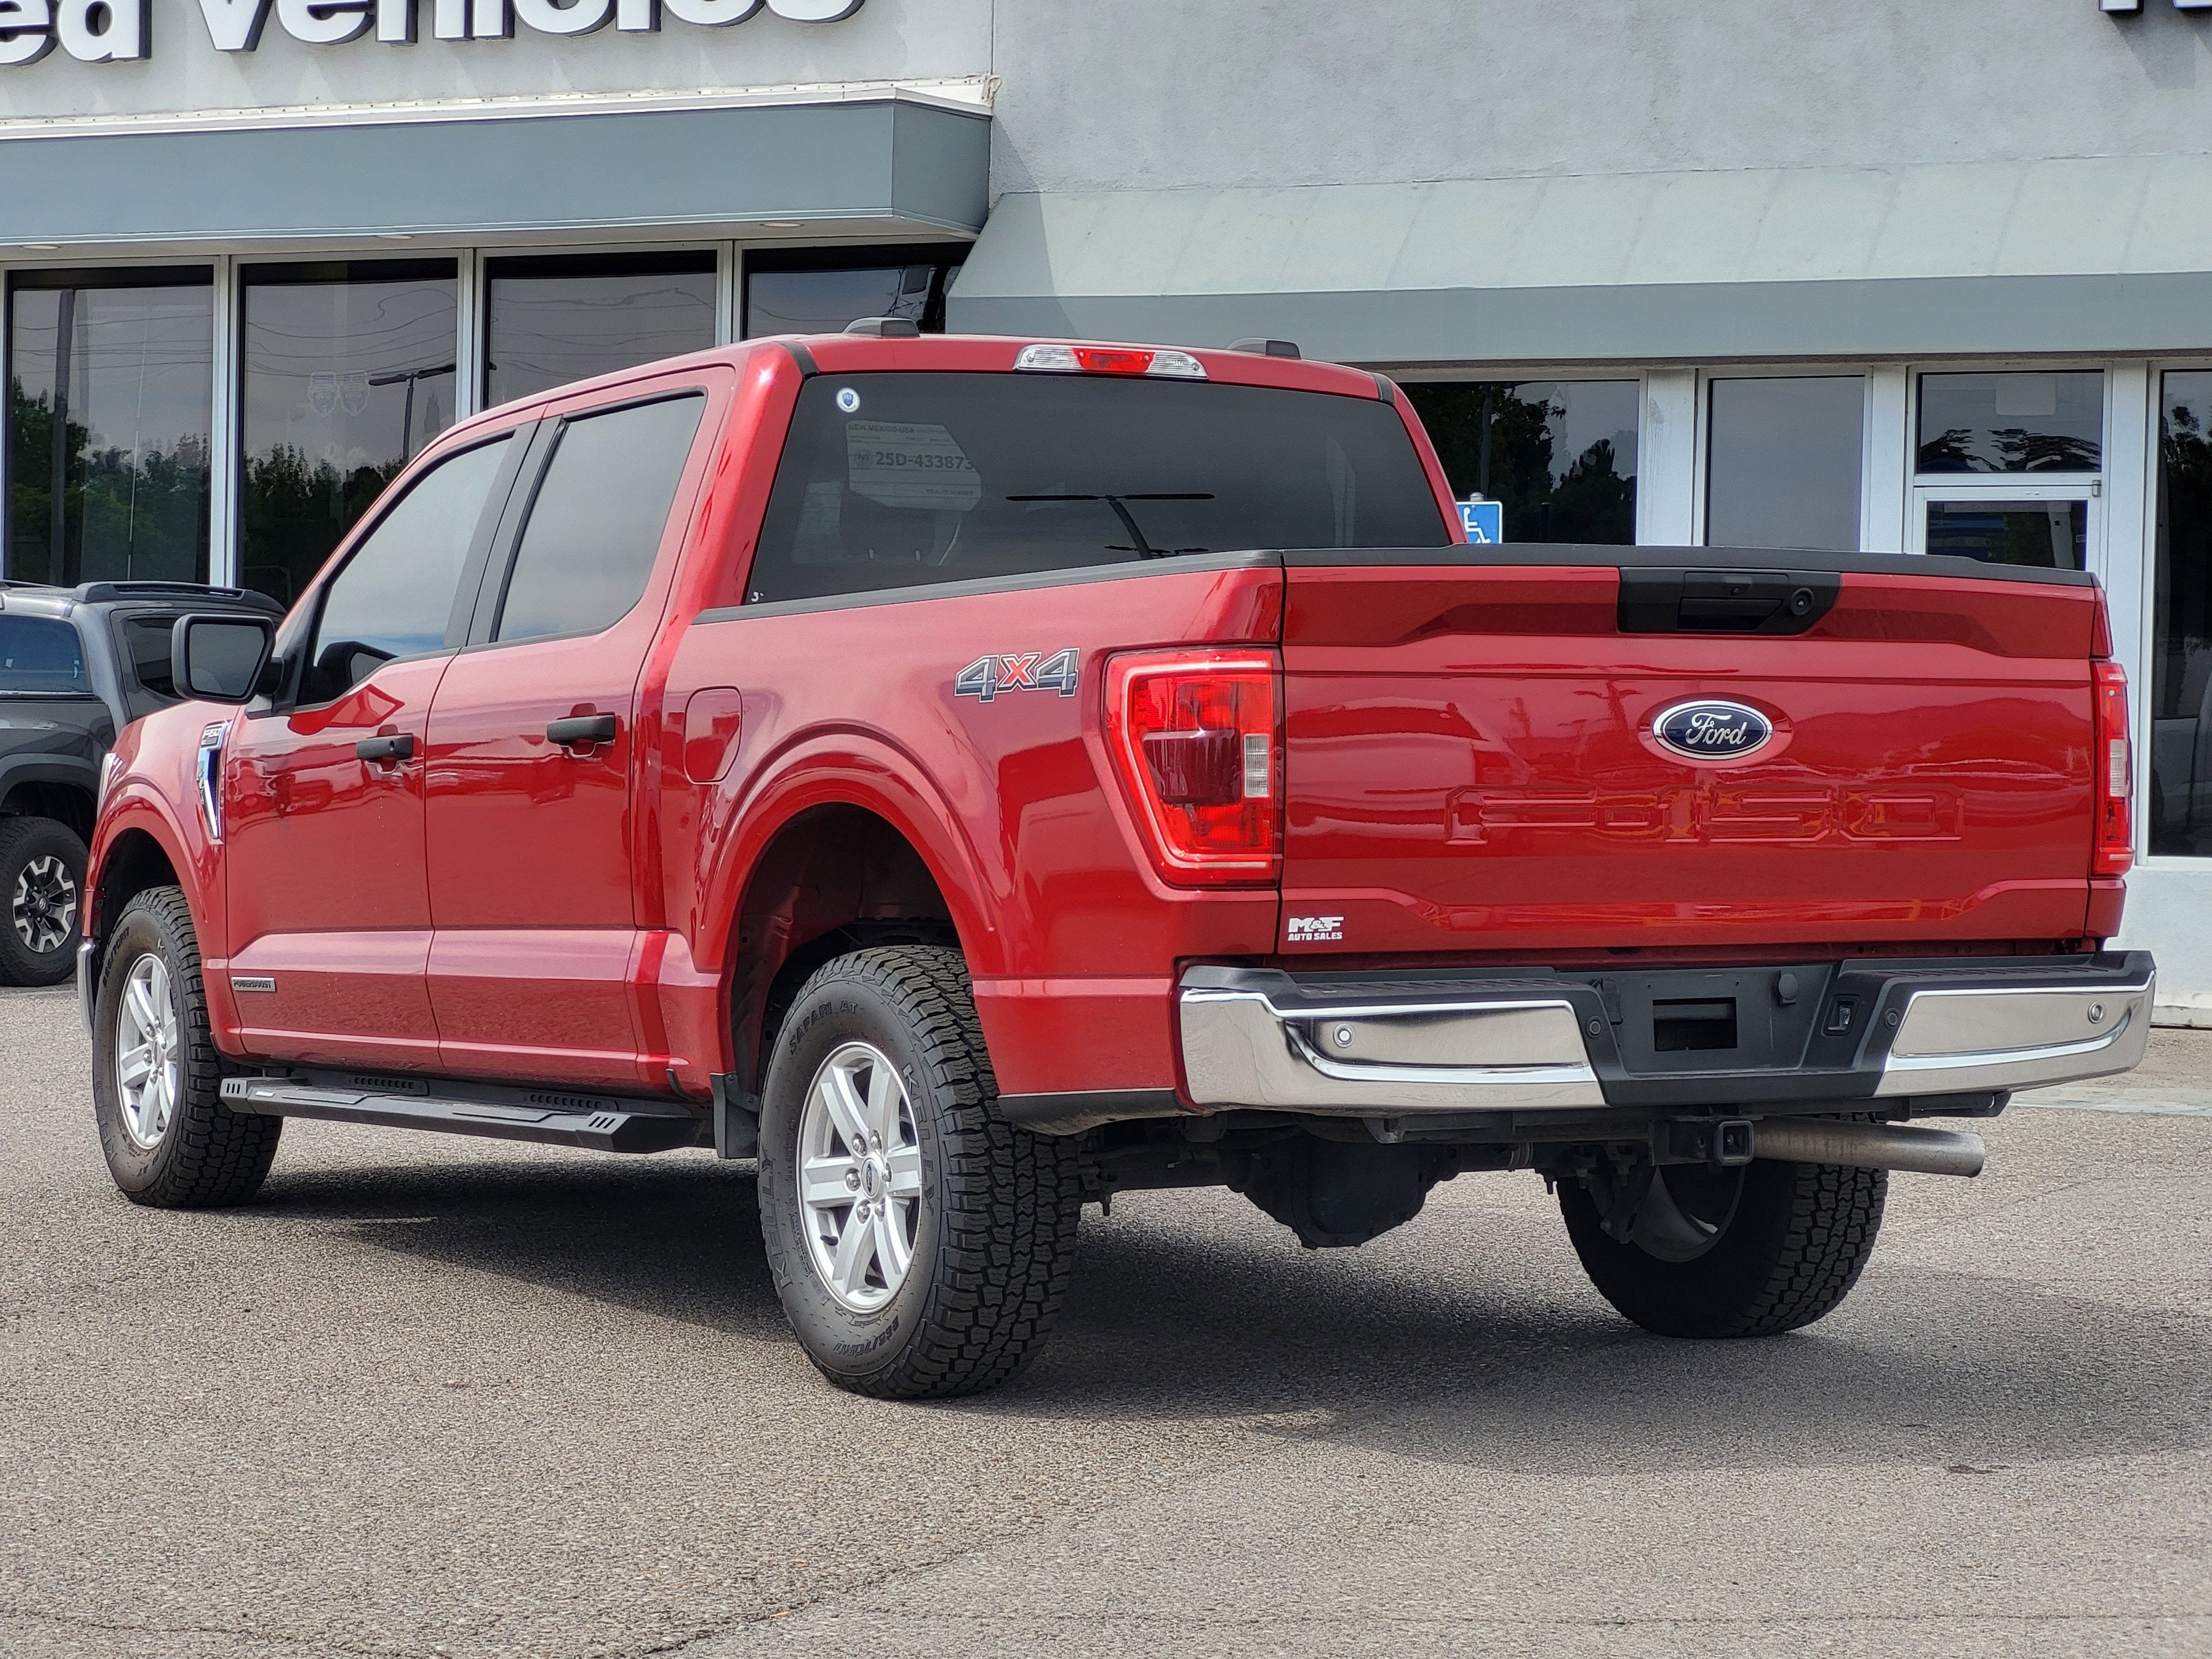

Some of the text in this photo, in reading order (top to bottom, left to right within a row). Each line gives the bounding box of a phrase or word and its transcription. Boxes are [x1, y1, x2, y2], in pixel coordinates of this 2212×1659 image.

[1685, 712, 1747, 745] Ford
[1288, 916, 1344, 933] M&F
[1288, 932, 1343, 941] AUTO SALES
[789, 1000, 858, 1055] SAFARI AT
